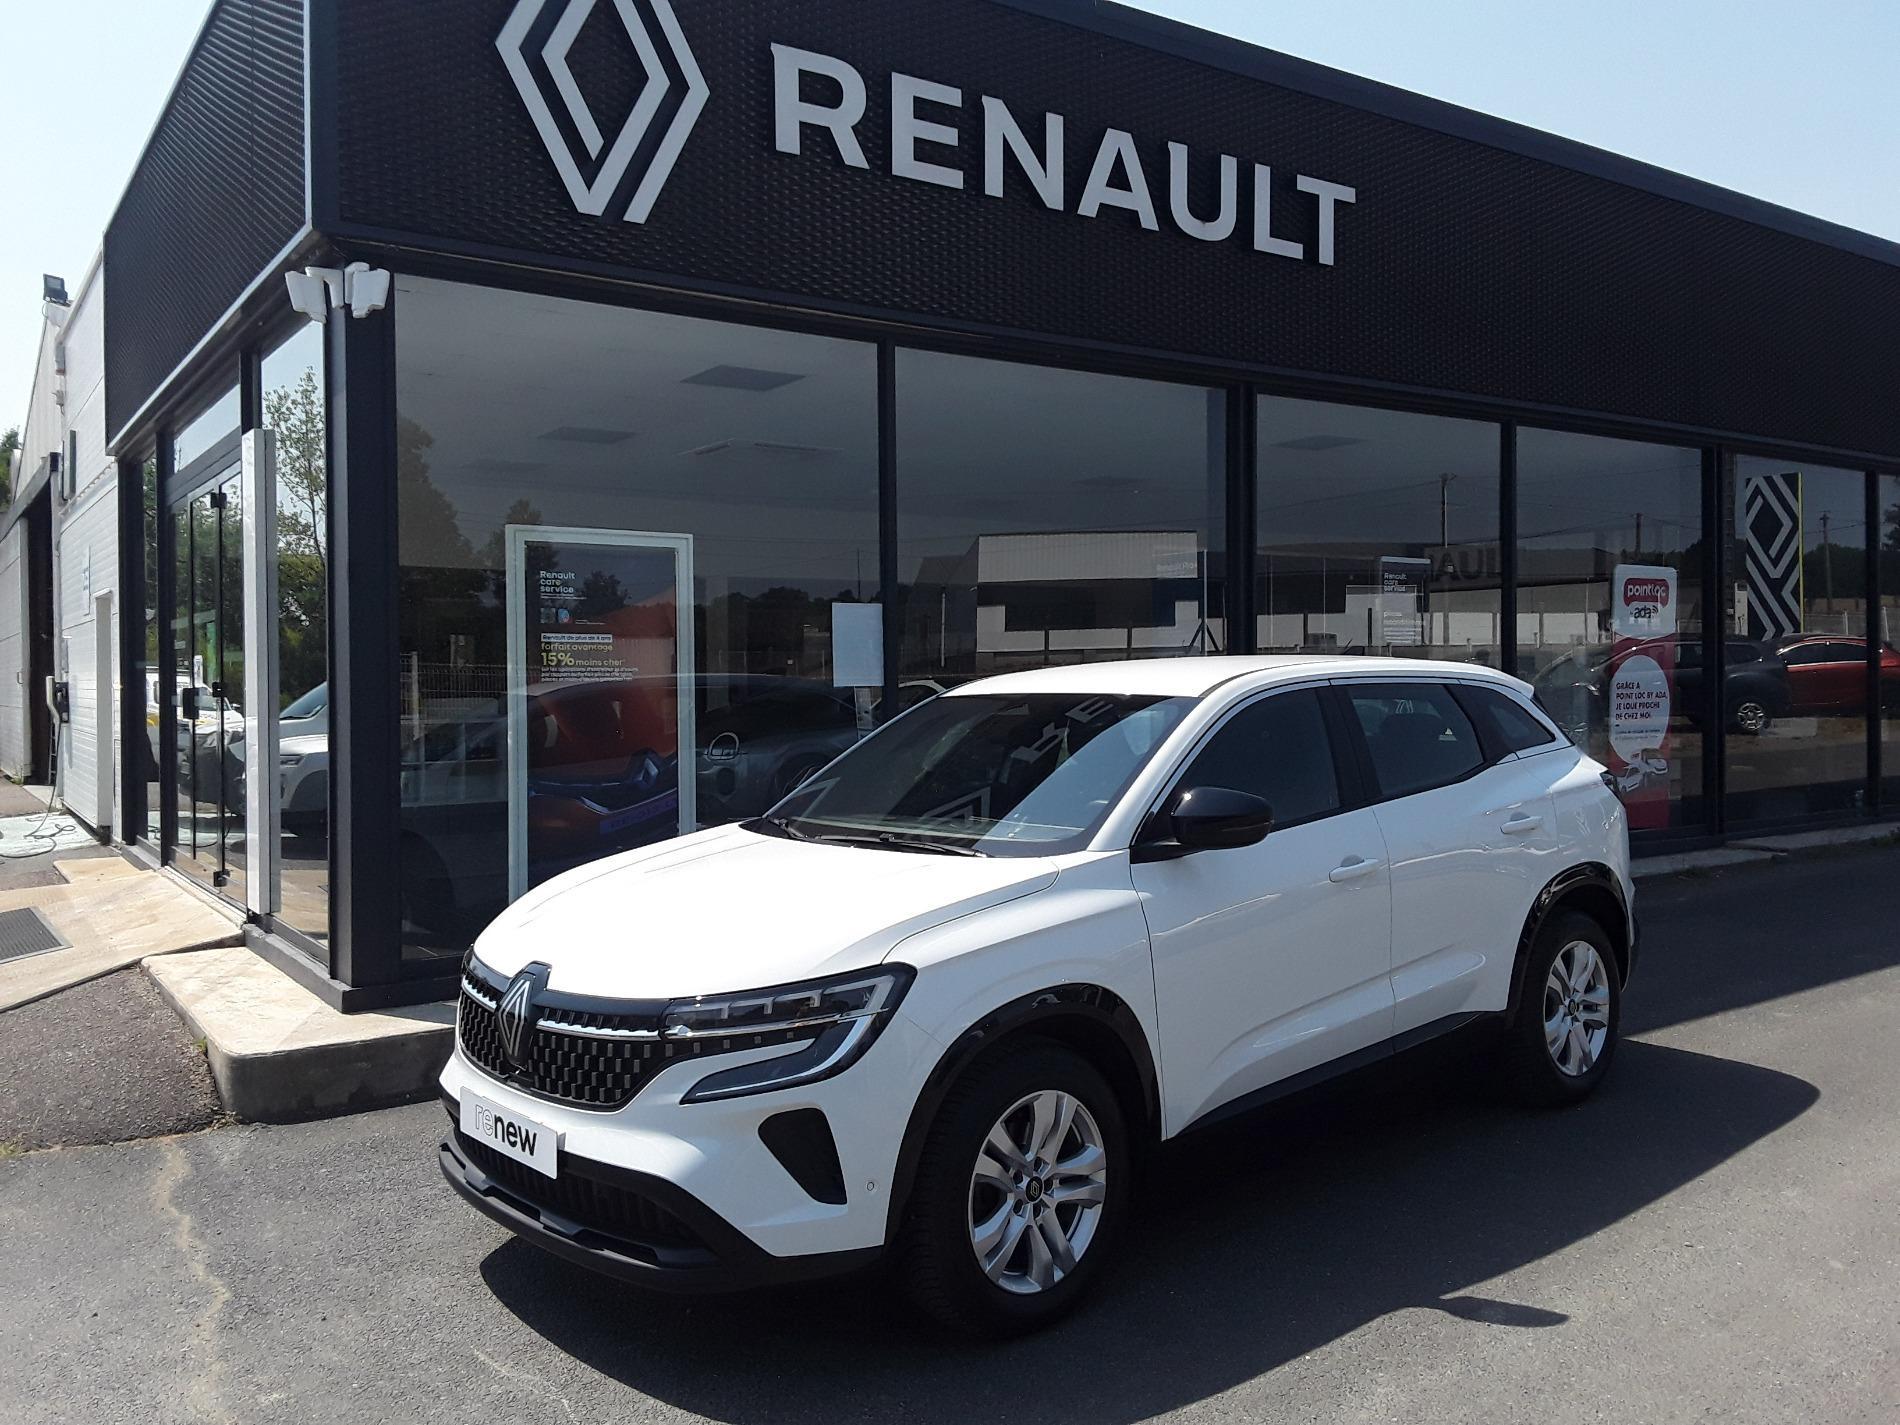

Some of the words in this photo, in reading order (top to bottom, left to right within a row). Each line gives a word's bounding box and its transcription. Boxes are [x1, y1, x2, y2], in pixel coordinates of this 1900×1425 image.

[770, 42, 1356, 266] RENAULT
[540, 570, 576, 580] Renault
[1384, 572, 1407, 580] Renault
[540, 585, 574, 594] service
[1634, 605, 1651, 619] ada
[541, 642, 571, 651] forfait
[571, 644, 613, 653] avantage
[541, 652, 575, 666] 15%
[575, 658, 603, 666] moins
[1616, 692, 1634, 700] POINT
[1635, 691, 1646, 700] LOC
[1647, 691, 1653, 699] BY
[1616, 702, 1622, 711] JE
[1623, 702, 1637, 710] LOUE
[1639, 701, 1660, 710] PROCHE
[1616, 713, 1622, 721] DE
[1623, 712, 1638, 720] CHEZ
[475, 1104, 538, 1156] renew
